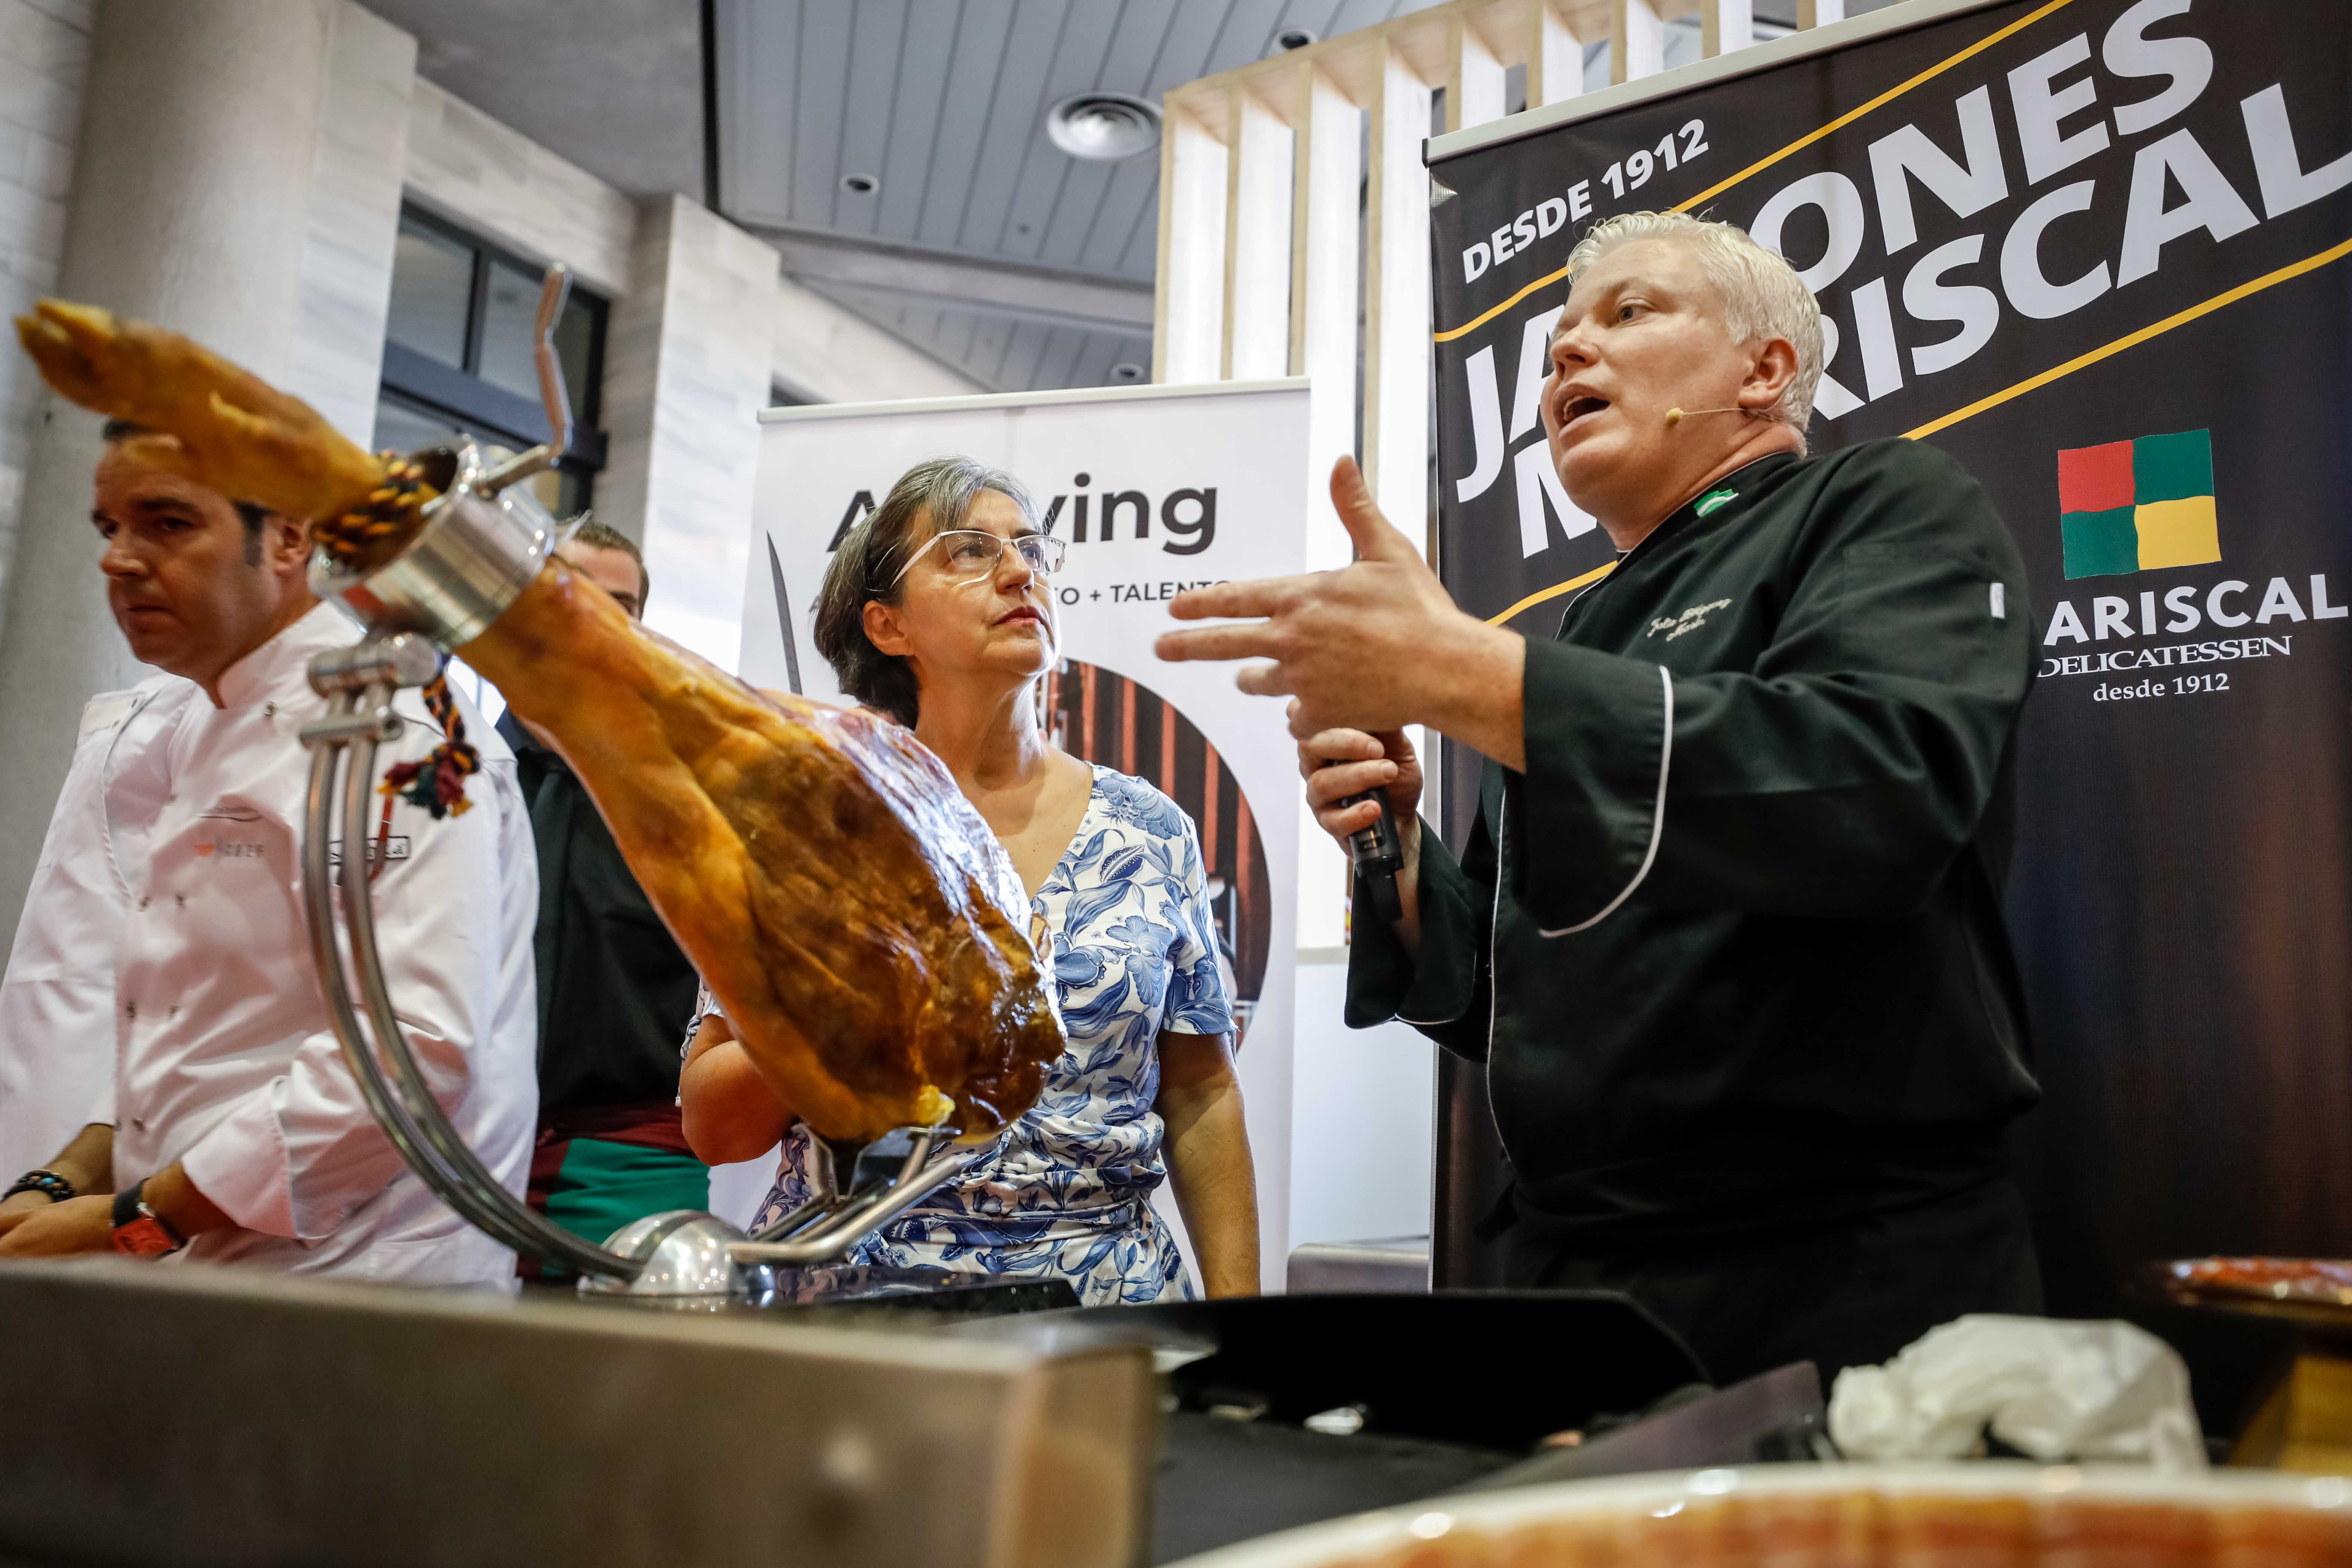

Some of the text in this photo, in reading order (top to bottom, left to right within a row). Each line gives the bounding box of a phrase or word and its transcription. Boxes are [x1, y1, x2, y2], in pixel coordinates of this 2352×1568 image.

[1462, 119, 1709, 284] DESDE 1912
[1456, 0, 2213, 503] JAONES
[2042, 573, 2349, 646] ARISCAL
[2036, 636, 2292, 678] DELICATESSEN
[2093, 673, 2230, 702] desde 1912
